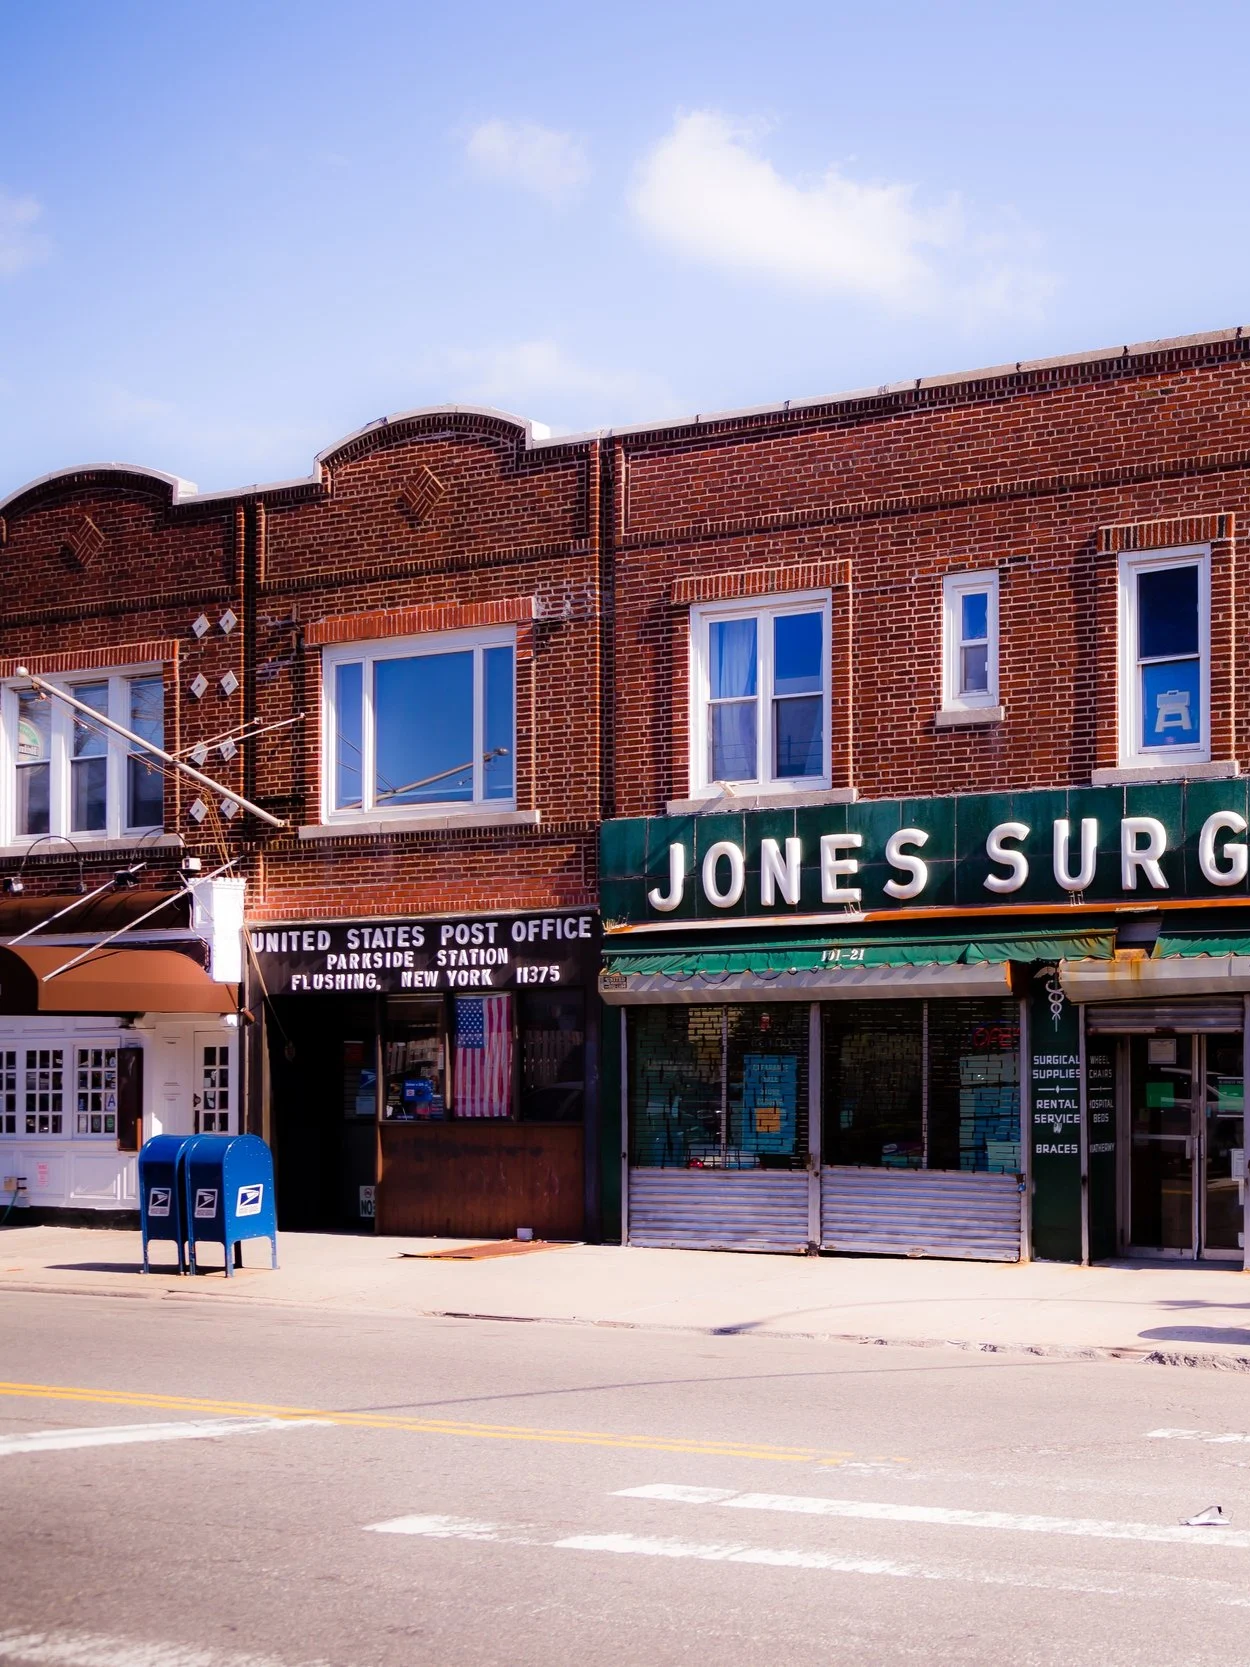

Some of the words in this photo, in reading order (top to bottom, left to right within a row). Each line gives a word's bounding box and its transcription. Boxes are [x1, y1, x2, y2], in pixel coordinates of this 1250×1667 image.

[648, 828, 929, 912] JONES
[251, 930, 331, 953] UNITED
[347, 925, 425, 949] STATES
[441, 922, 498, 946] POST
[511, 916, 592, 943] OFFICE
[327, 951, 414, 970] PARKSIDE
[437, 947, 509, 967] STATION
[401, 970, 439, 988] NEW
[447, 968, 493, 987] YORK
[516, 966, 560, 984] 11375
[1033, 1055, 1080, 1065] SURGICAL
[1090, 1055, 1110, 1065] WHEEL
[1032, 1068, 1080, 1079] SUPPLIES
[1089, 1069, 1112, 1079] CHAIRS
[1036, 1099, 1078, 1109] RENTAL
[1034, 1113, 1080, 1124] SERVICE
[1093, 1113, 1109, 1123] BEDS
[1035, 1144, 1078, 1154] BRACES
